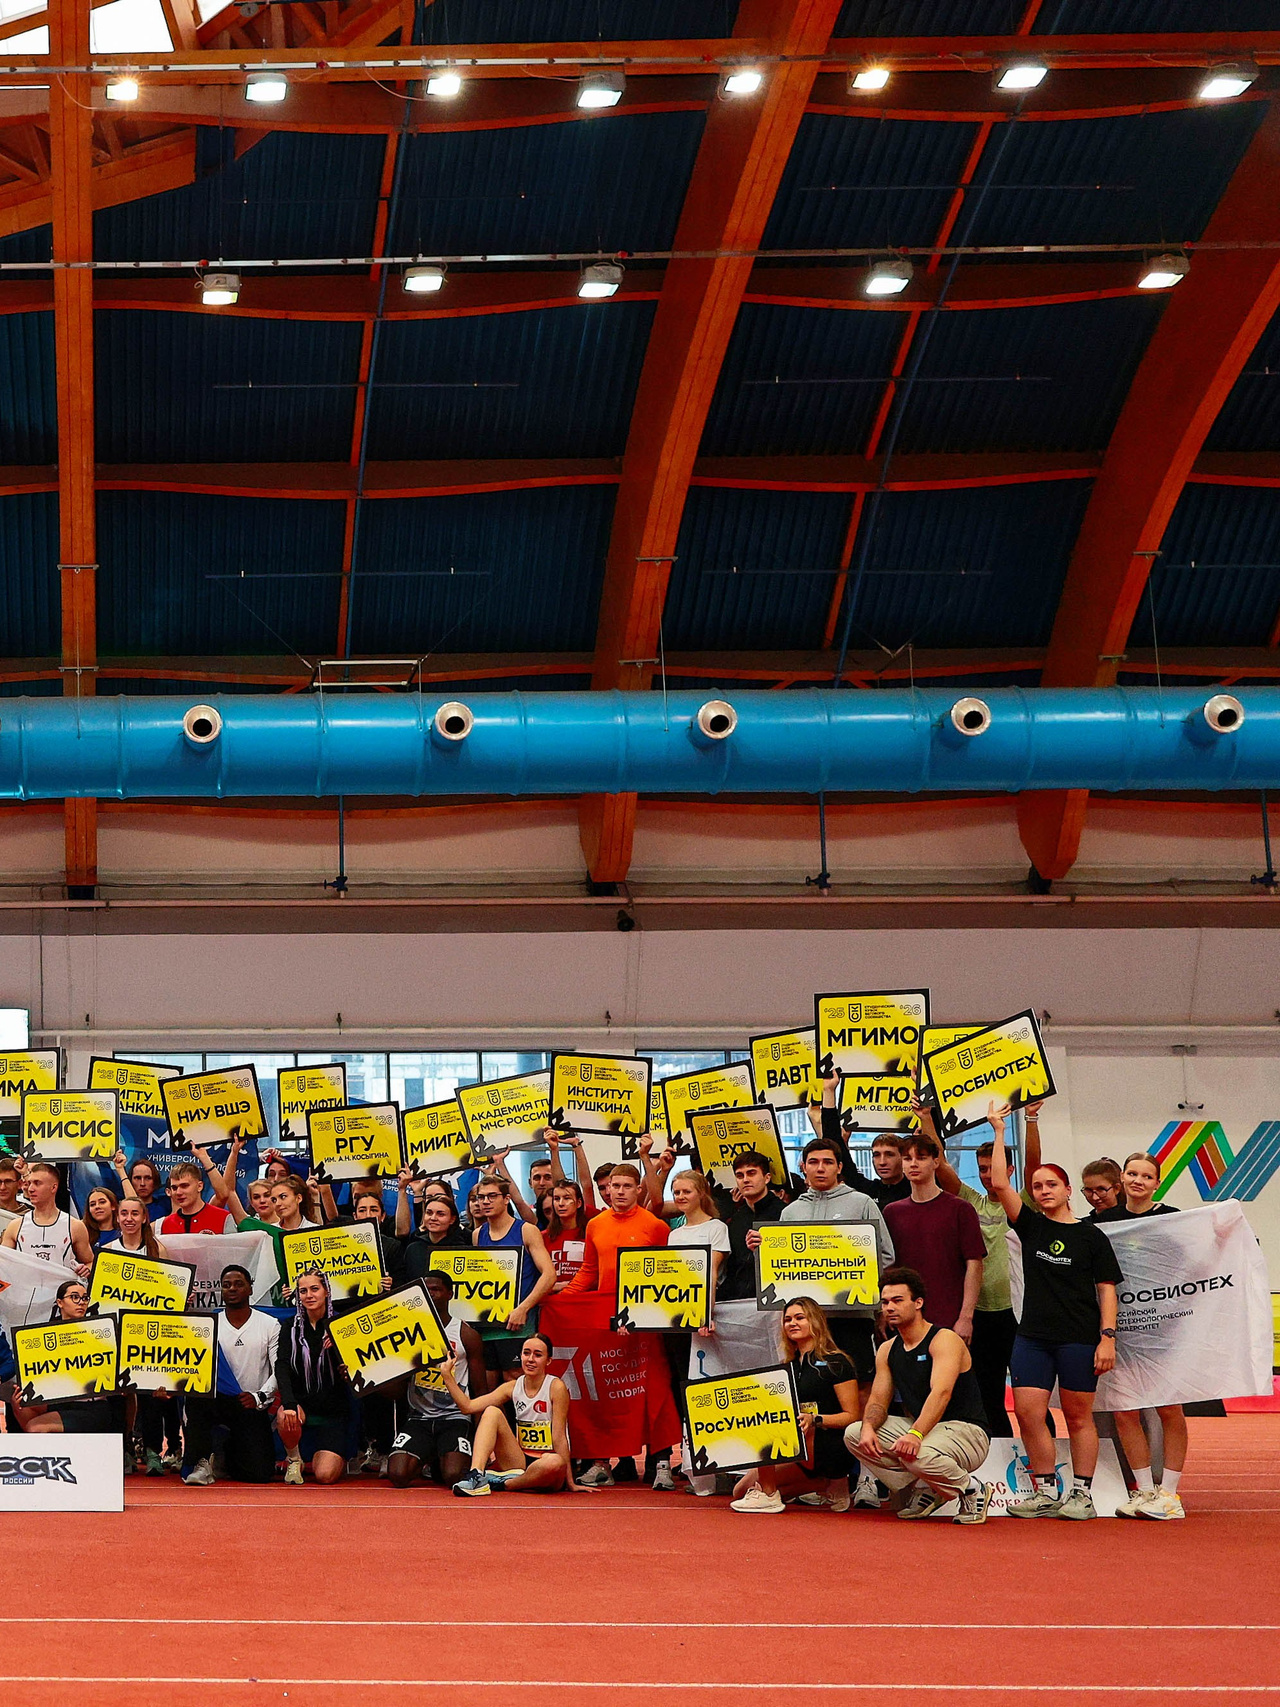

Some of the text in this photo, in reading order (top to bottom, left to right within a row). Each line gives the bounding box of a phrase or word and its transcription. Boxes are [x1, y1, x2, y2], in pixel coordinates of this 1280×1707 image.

[828, 1026, 918, 1047] МГИМО
[767, 1063, 812, 1088] ВАВТ
[942, 1052, 1038, 1103] РОСБИОТЕХ
[567, 1085, 633, 1100] ИНСТИТУТ
[856, 1086, 913, 1103] МГЮ
[178, 1101, 251, 1124] НИУ ВШЭ
[283, 1101, 307, 1114] НИУ
[471, 1102, 533, 1122] АКАДЕМИЯ
[567, 1100, 631, 1114] ПУШКИНА
[27, 1120, 113, 1139] МИСИС
[480, 1120, 505, 1131] МЧС
[336, 1135, 375, 1154] РГУ
[352, 1152, 389, 1161] КОСЫГИНА
[295, 1252, 371, 1273] РГАУ-МСХА
[771, 1256, 866, 1269] ЦЕНТРАЛЬНЫЙ
[774, 1271, 865, 1280] УНИВЕРСИТЕТ
[101, 1285, 176, 1310] РАНХиГС
[452, 1281, 510, 1300] ТУСИ
[623, 1284, 703, 1303] МГУСиТ
[354, 1322, 427, 1368] МГРИ
[24, 1351, 114, 1376] НИУ МИЭТ
[127, 1345, 208, 1365] РНИМУ
[161, 1366, 199, 1375] ПИРОГОВА
[609, 1386, 645, 1399] СПОРТА
[694, 1410, 791, 1436] РосУниМед
[520, 1429, 546, 1443] 281
